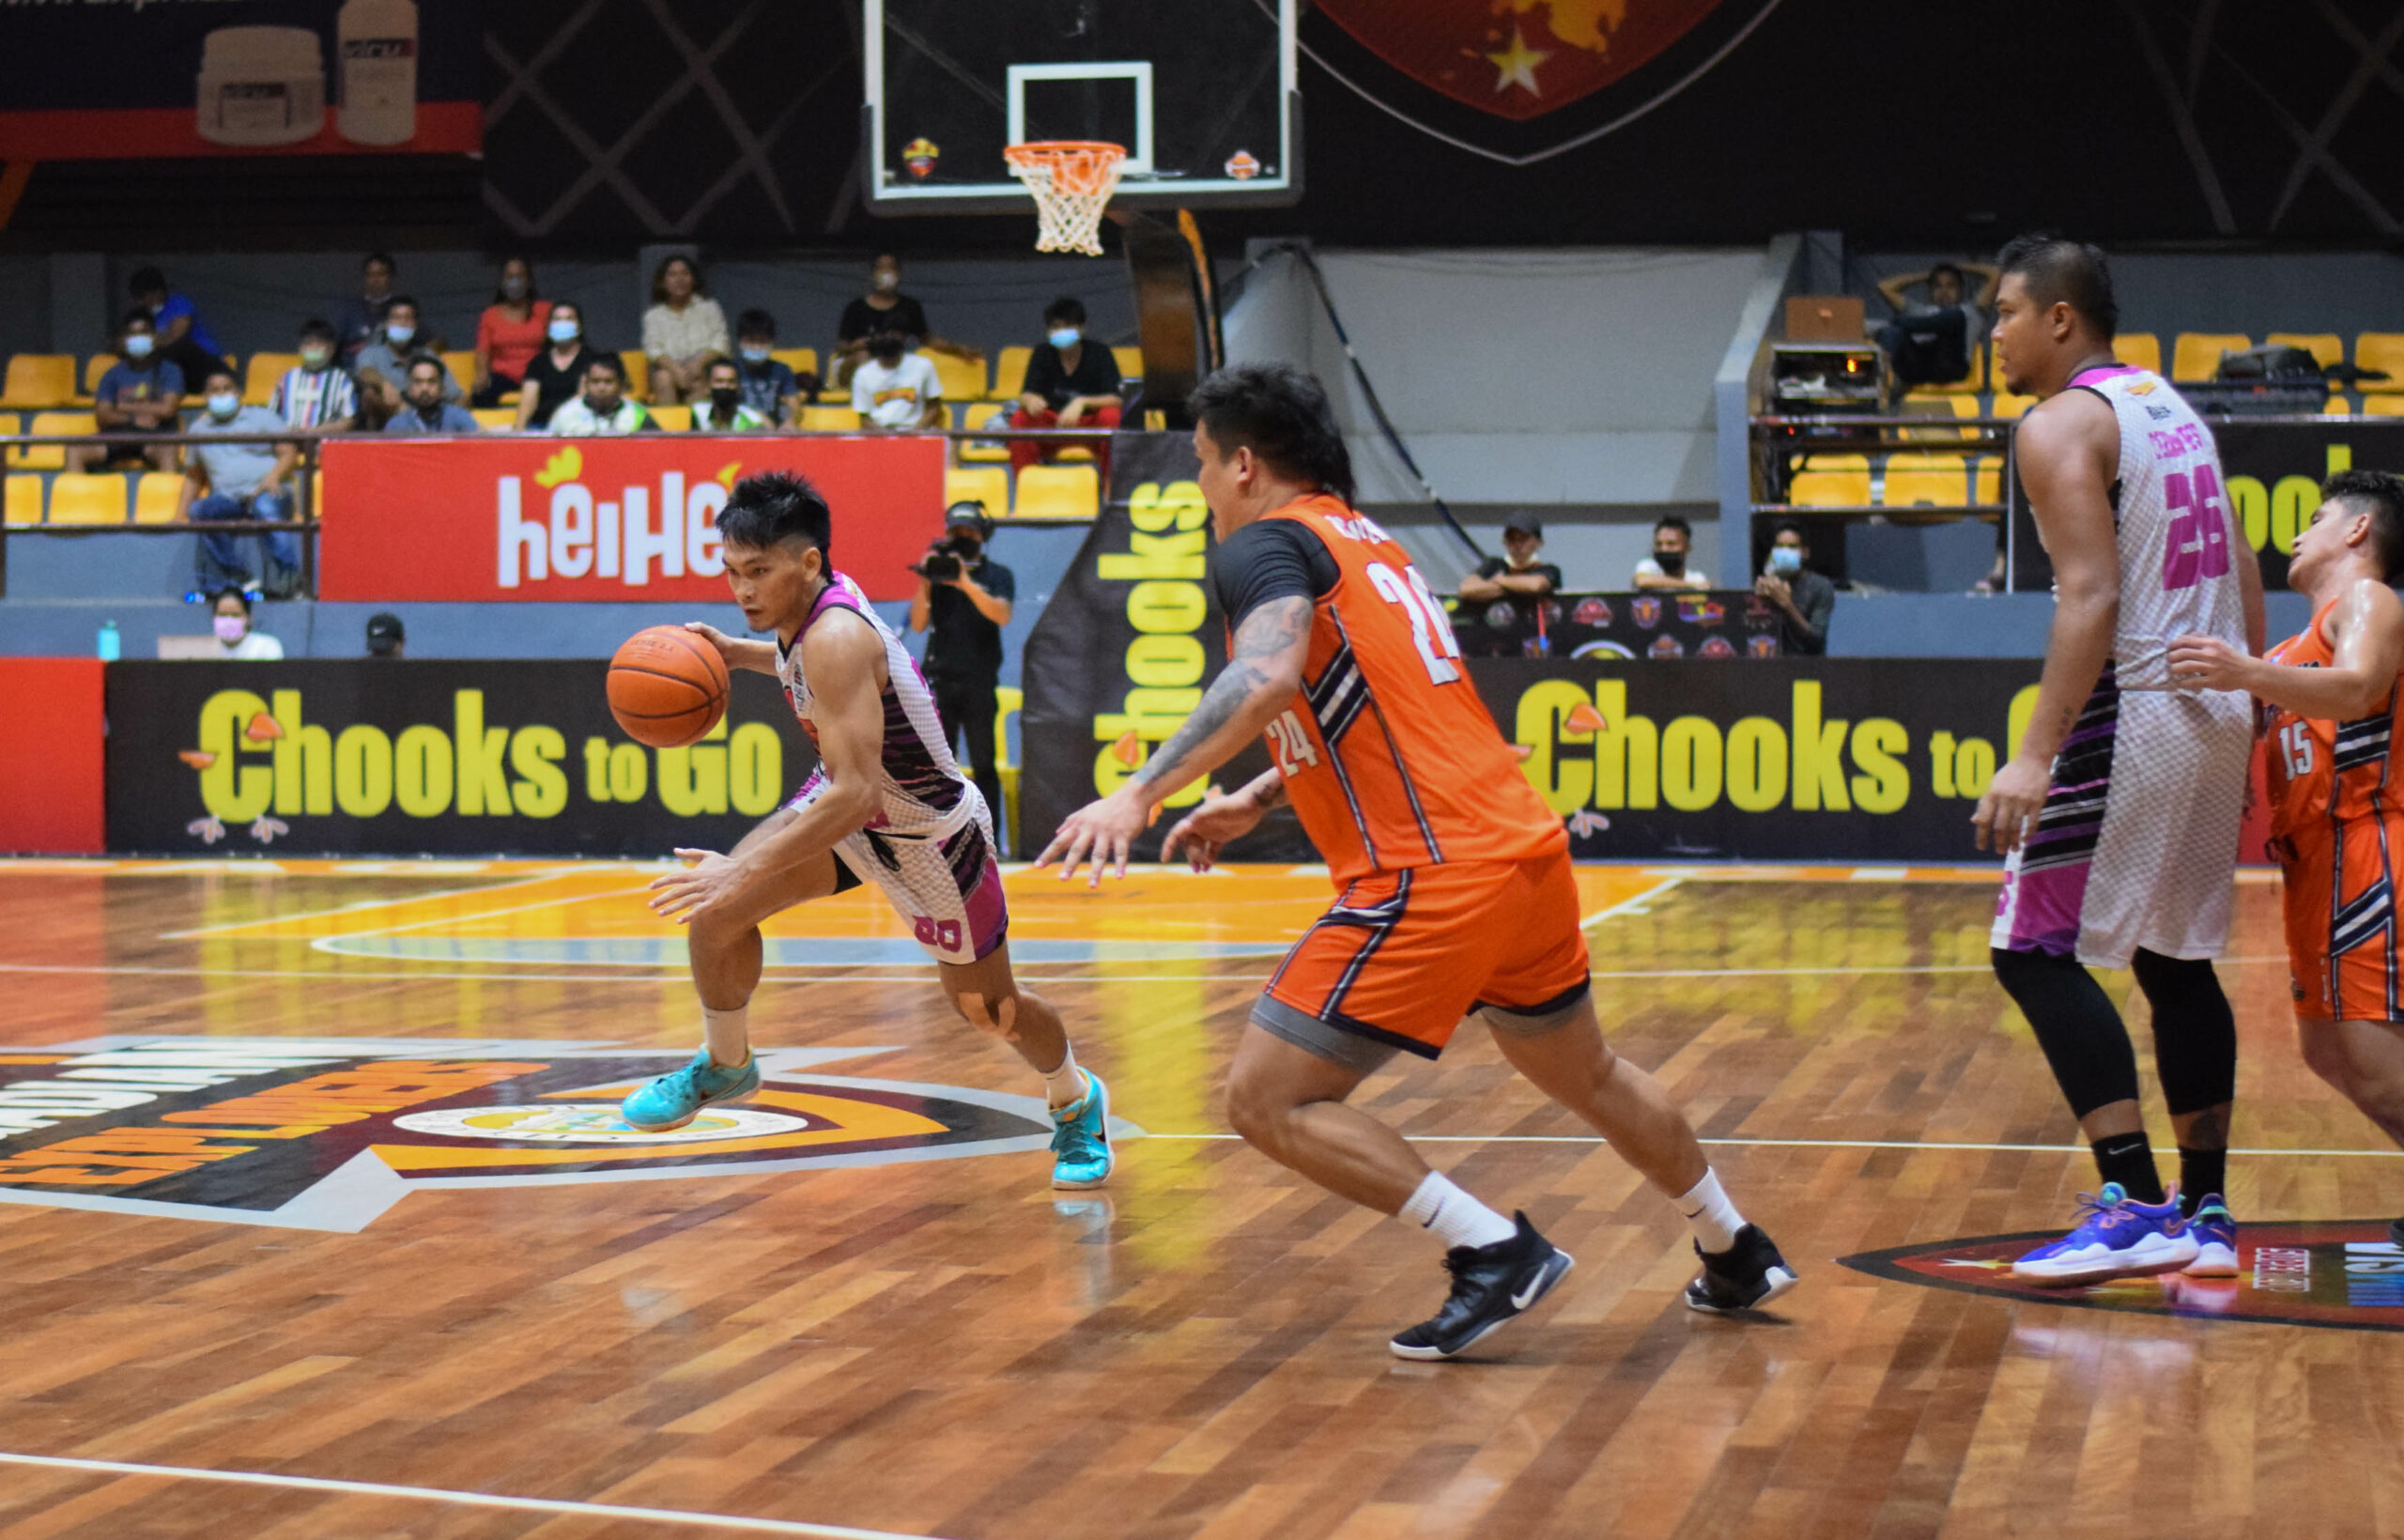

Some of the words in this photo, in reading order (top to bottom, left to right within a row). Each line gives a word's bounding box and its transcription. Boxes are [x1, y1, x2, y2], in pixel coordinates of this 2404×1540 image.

[199, 688, 569, 824] Chooks
[584, 736, 648, 803] to
[1264, 709, 1318, 778] 24
[1516, 679, 1910, 817] Chooks
[1930, 730, 1996, 800] to
[2279, 720, 2313, 781] 15
